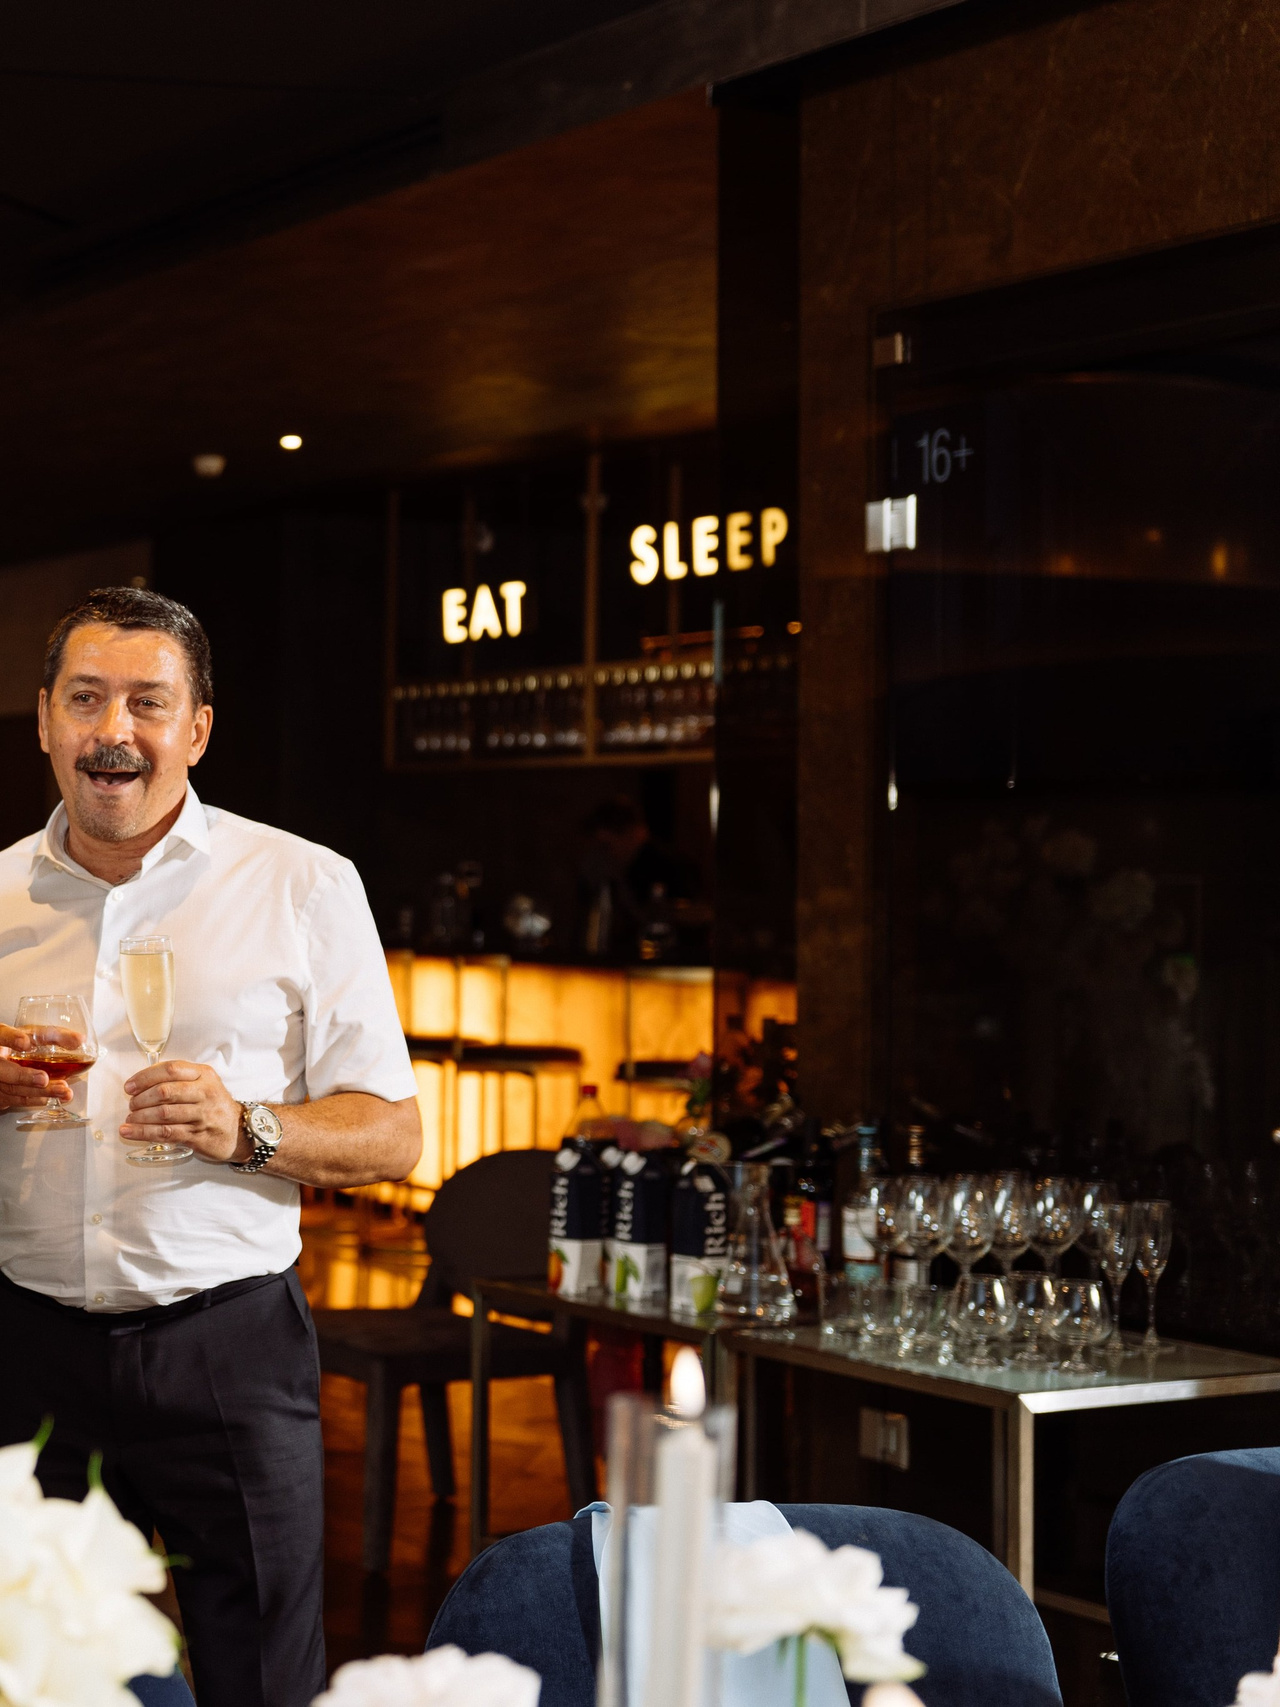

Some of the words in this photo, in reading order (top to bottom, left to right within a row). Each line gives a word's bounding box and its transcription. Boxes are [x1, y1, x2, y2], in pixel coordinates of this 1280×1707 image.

[915, 427, 975, 484] 16+
[629, 506, 789, 586] SLEEP
[441, 579, 527, 645] EAT
[549, 1176, 570, 1238] Rich
[615, 1180, 635, 1241] Rich
[704, 1192, 726, 1256] Rich
